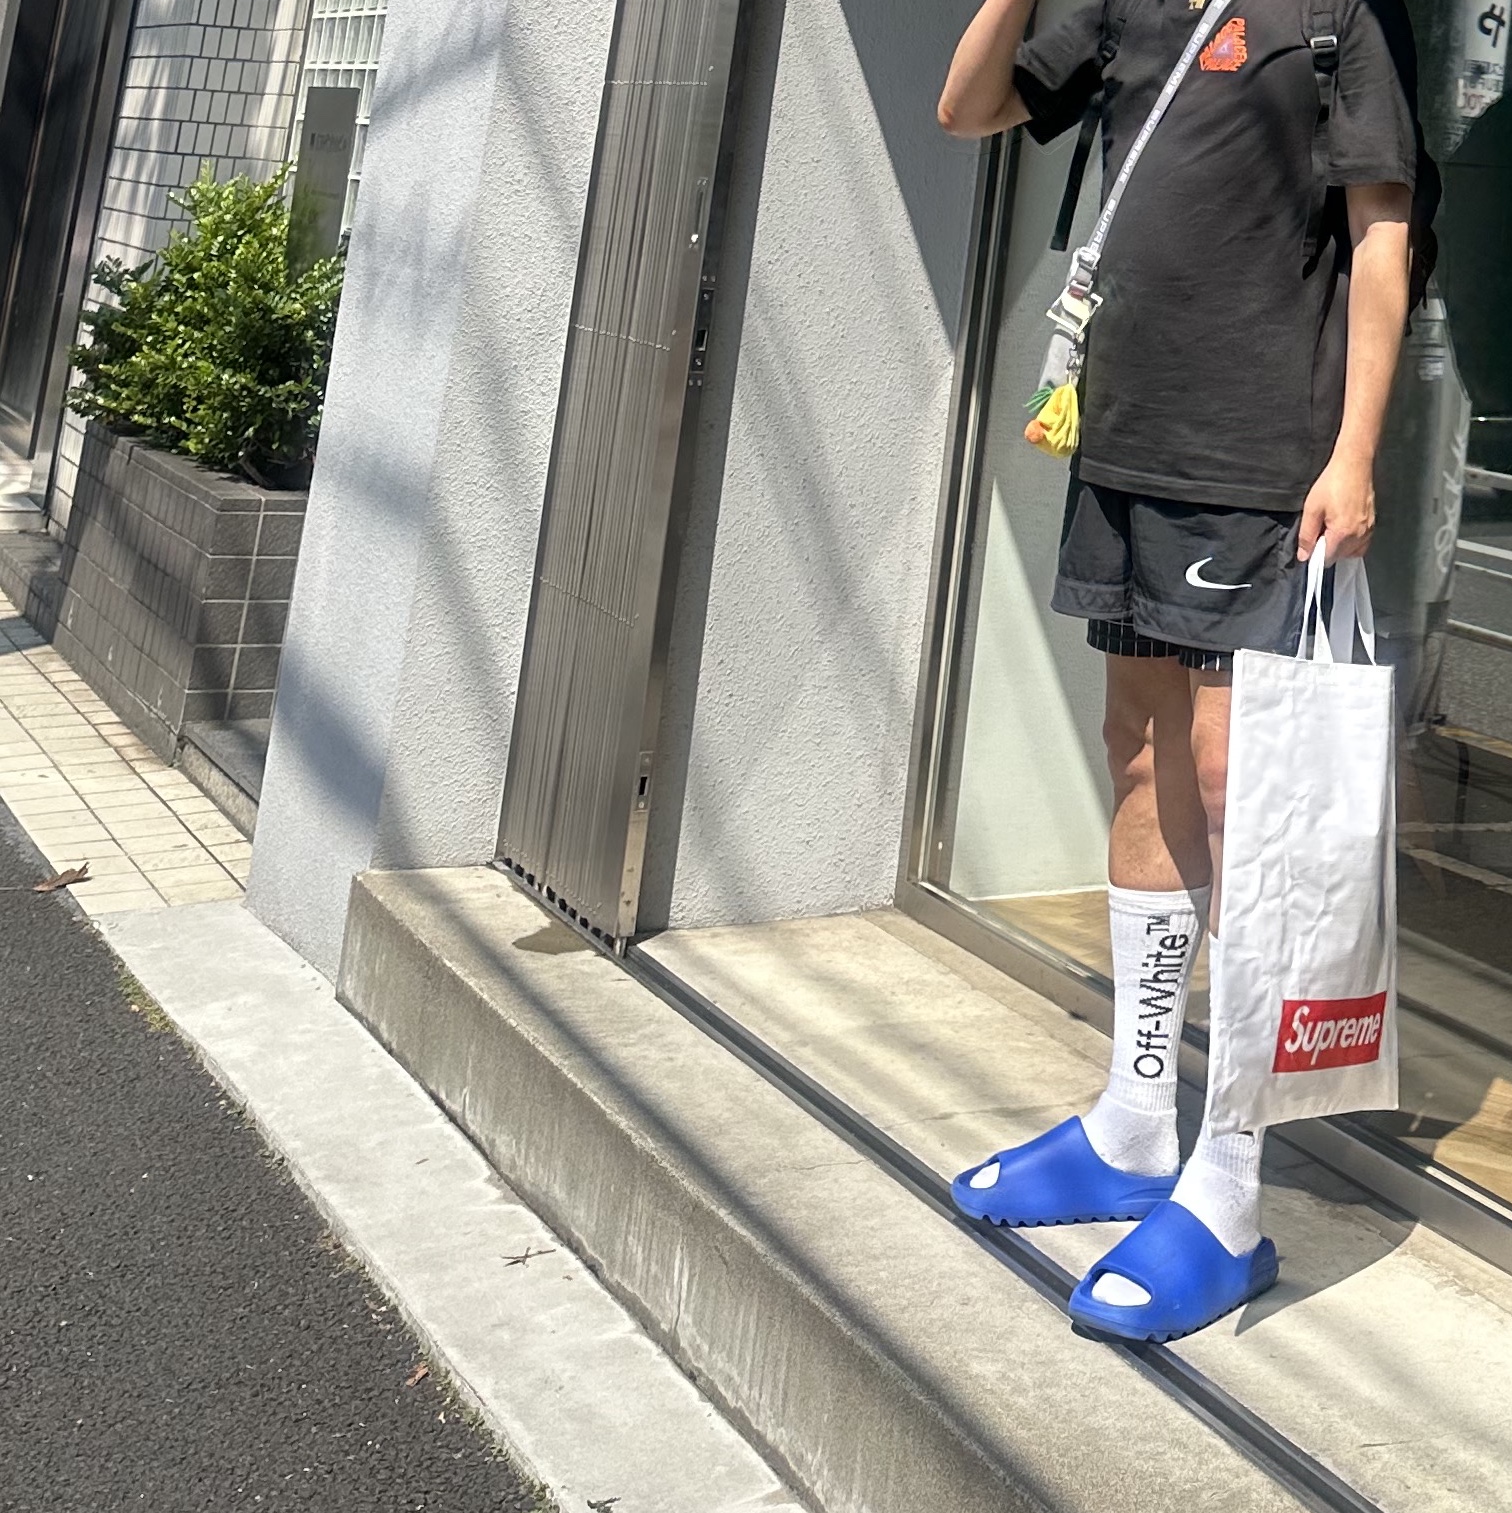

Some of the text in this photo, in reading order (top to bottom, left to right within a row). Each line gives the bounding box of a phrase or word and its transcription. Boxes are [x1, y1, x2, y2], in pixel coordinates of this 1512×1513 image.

[1166, 22, 1210, 95] SUPREME
[1118, 108, 1161, 184] SUPREME
[1284, 1005, 1381, 1065] Supreme
